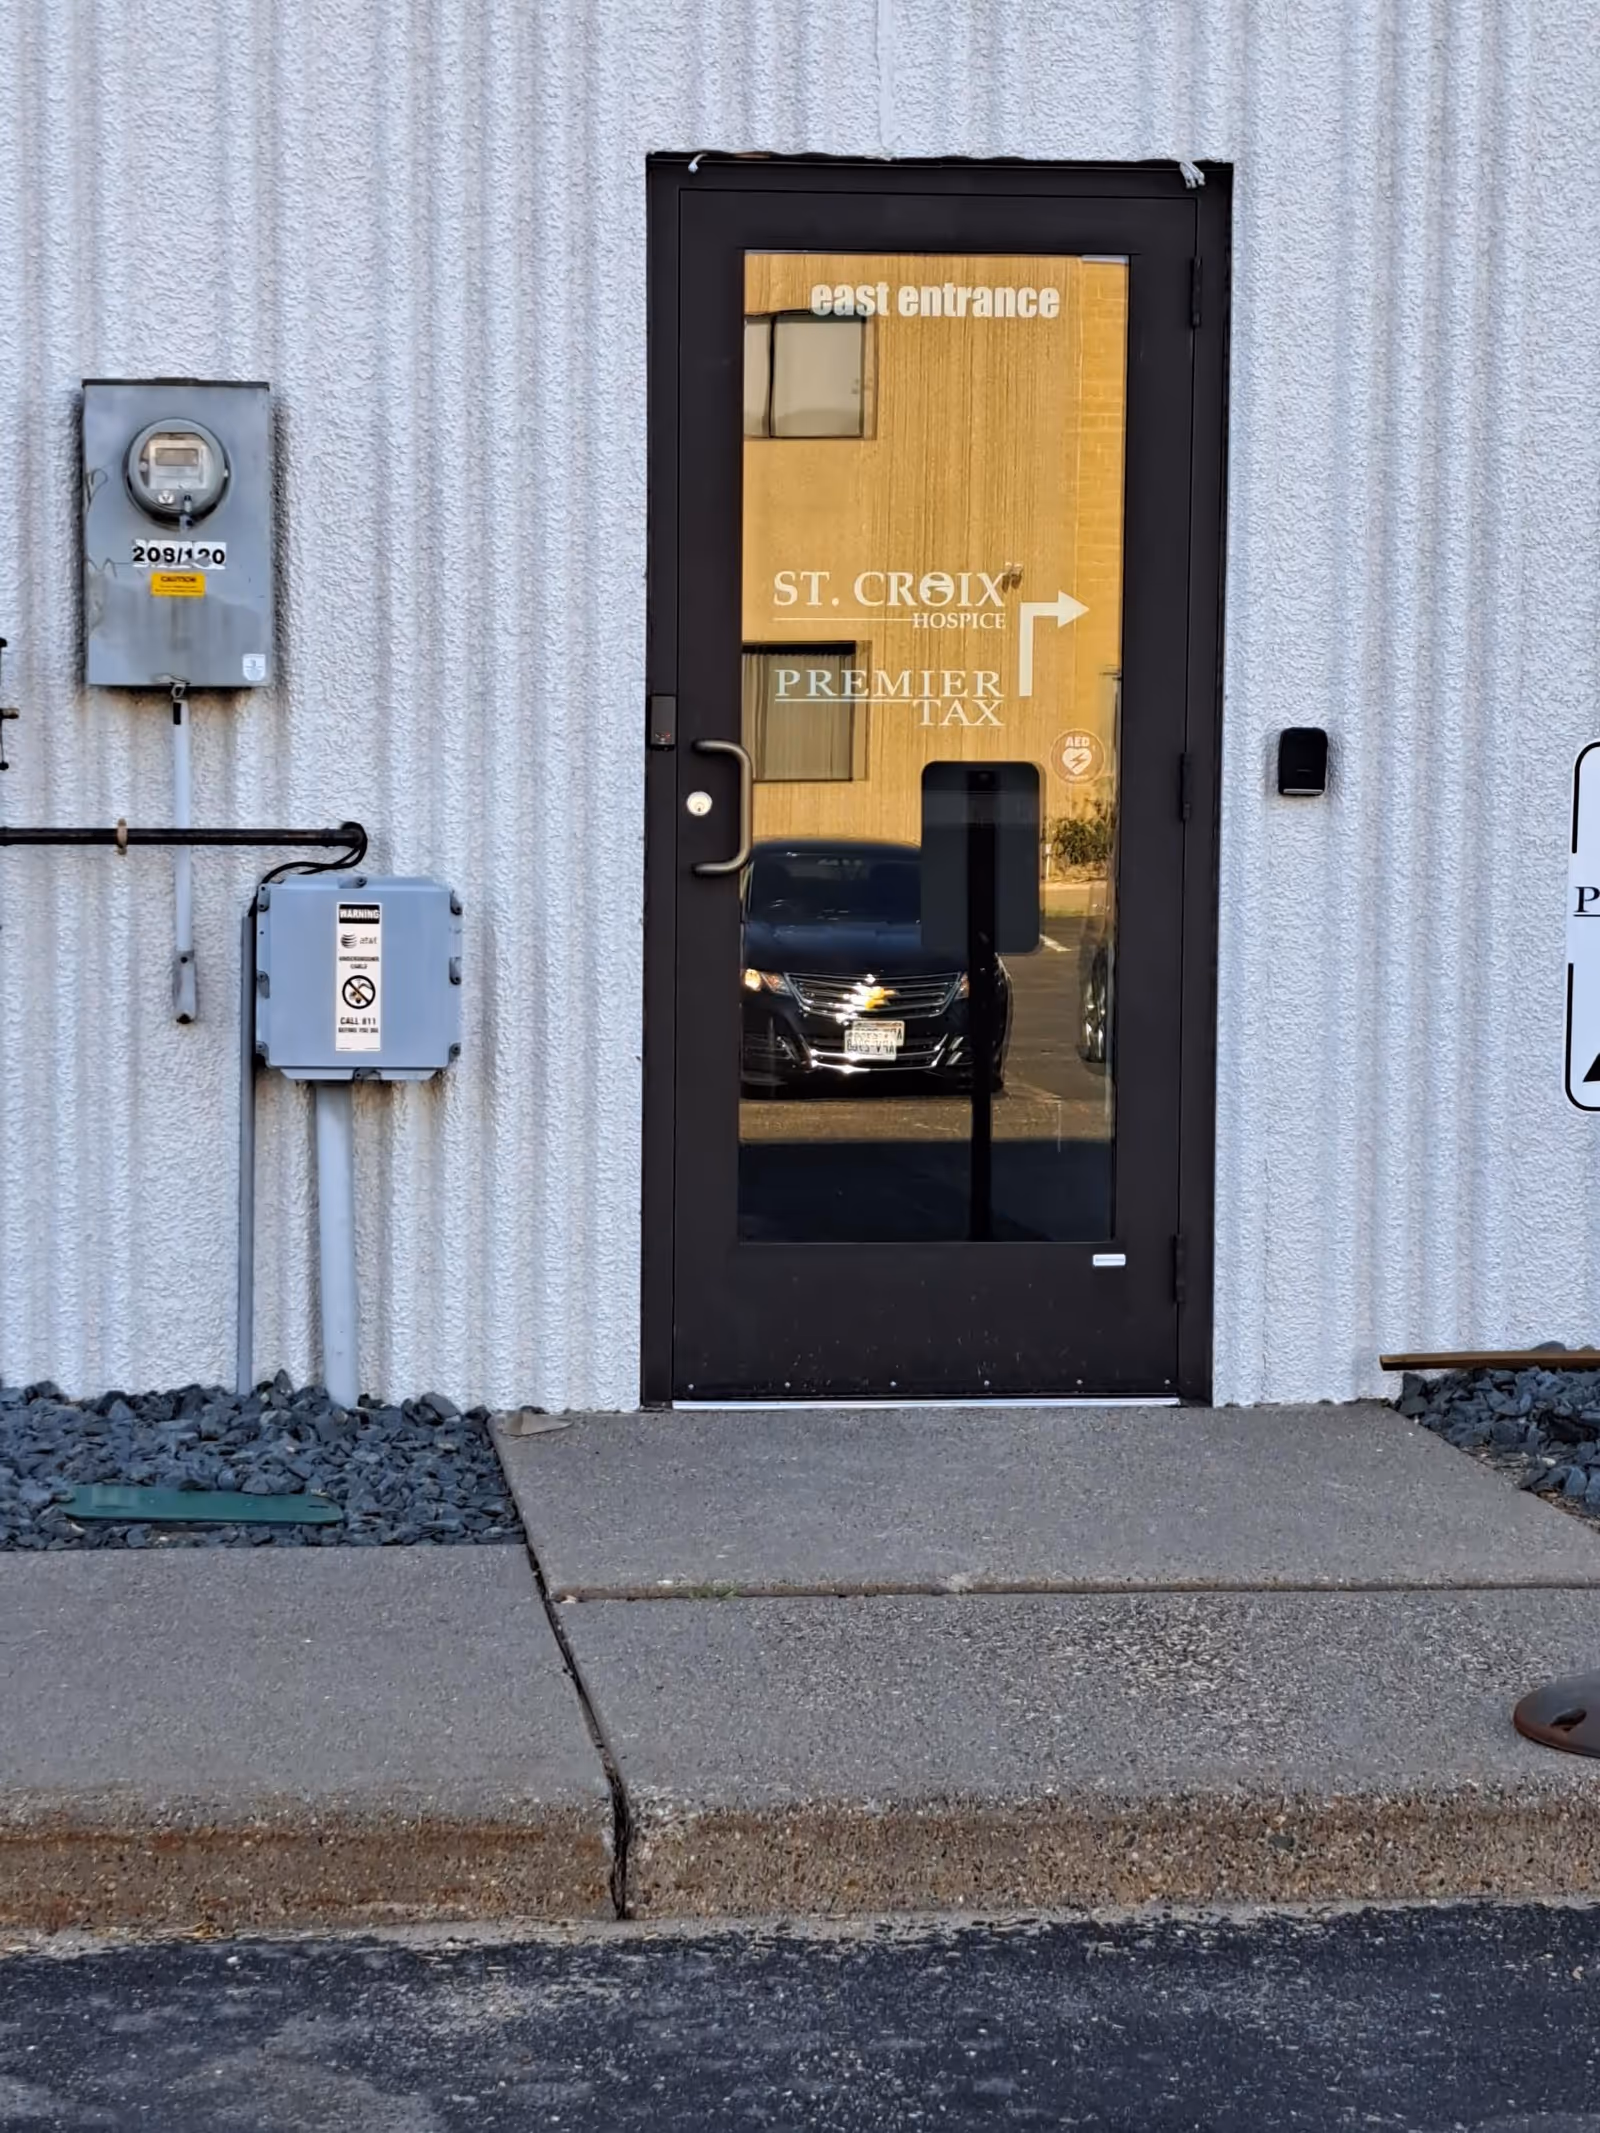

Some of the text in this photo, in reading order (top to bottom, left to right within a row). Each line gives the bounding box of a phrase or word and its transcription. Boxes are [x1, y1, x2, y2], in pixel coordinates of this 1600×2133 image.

[811, 282, 1060, 318] east entrance
[773, 570, 1006, 607] ST. CROIX
[911, 612, 1006, 630] HOSPICE
[774, 669, 1005, 698] PREMIER
[913, 699, 1005, 727] TAX
[1065, 736, 1090, 747] AED
[339, 908, 380, 919] WARNING
[340, 1016, 360, 1025] CALL
